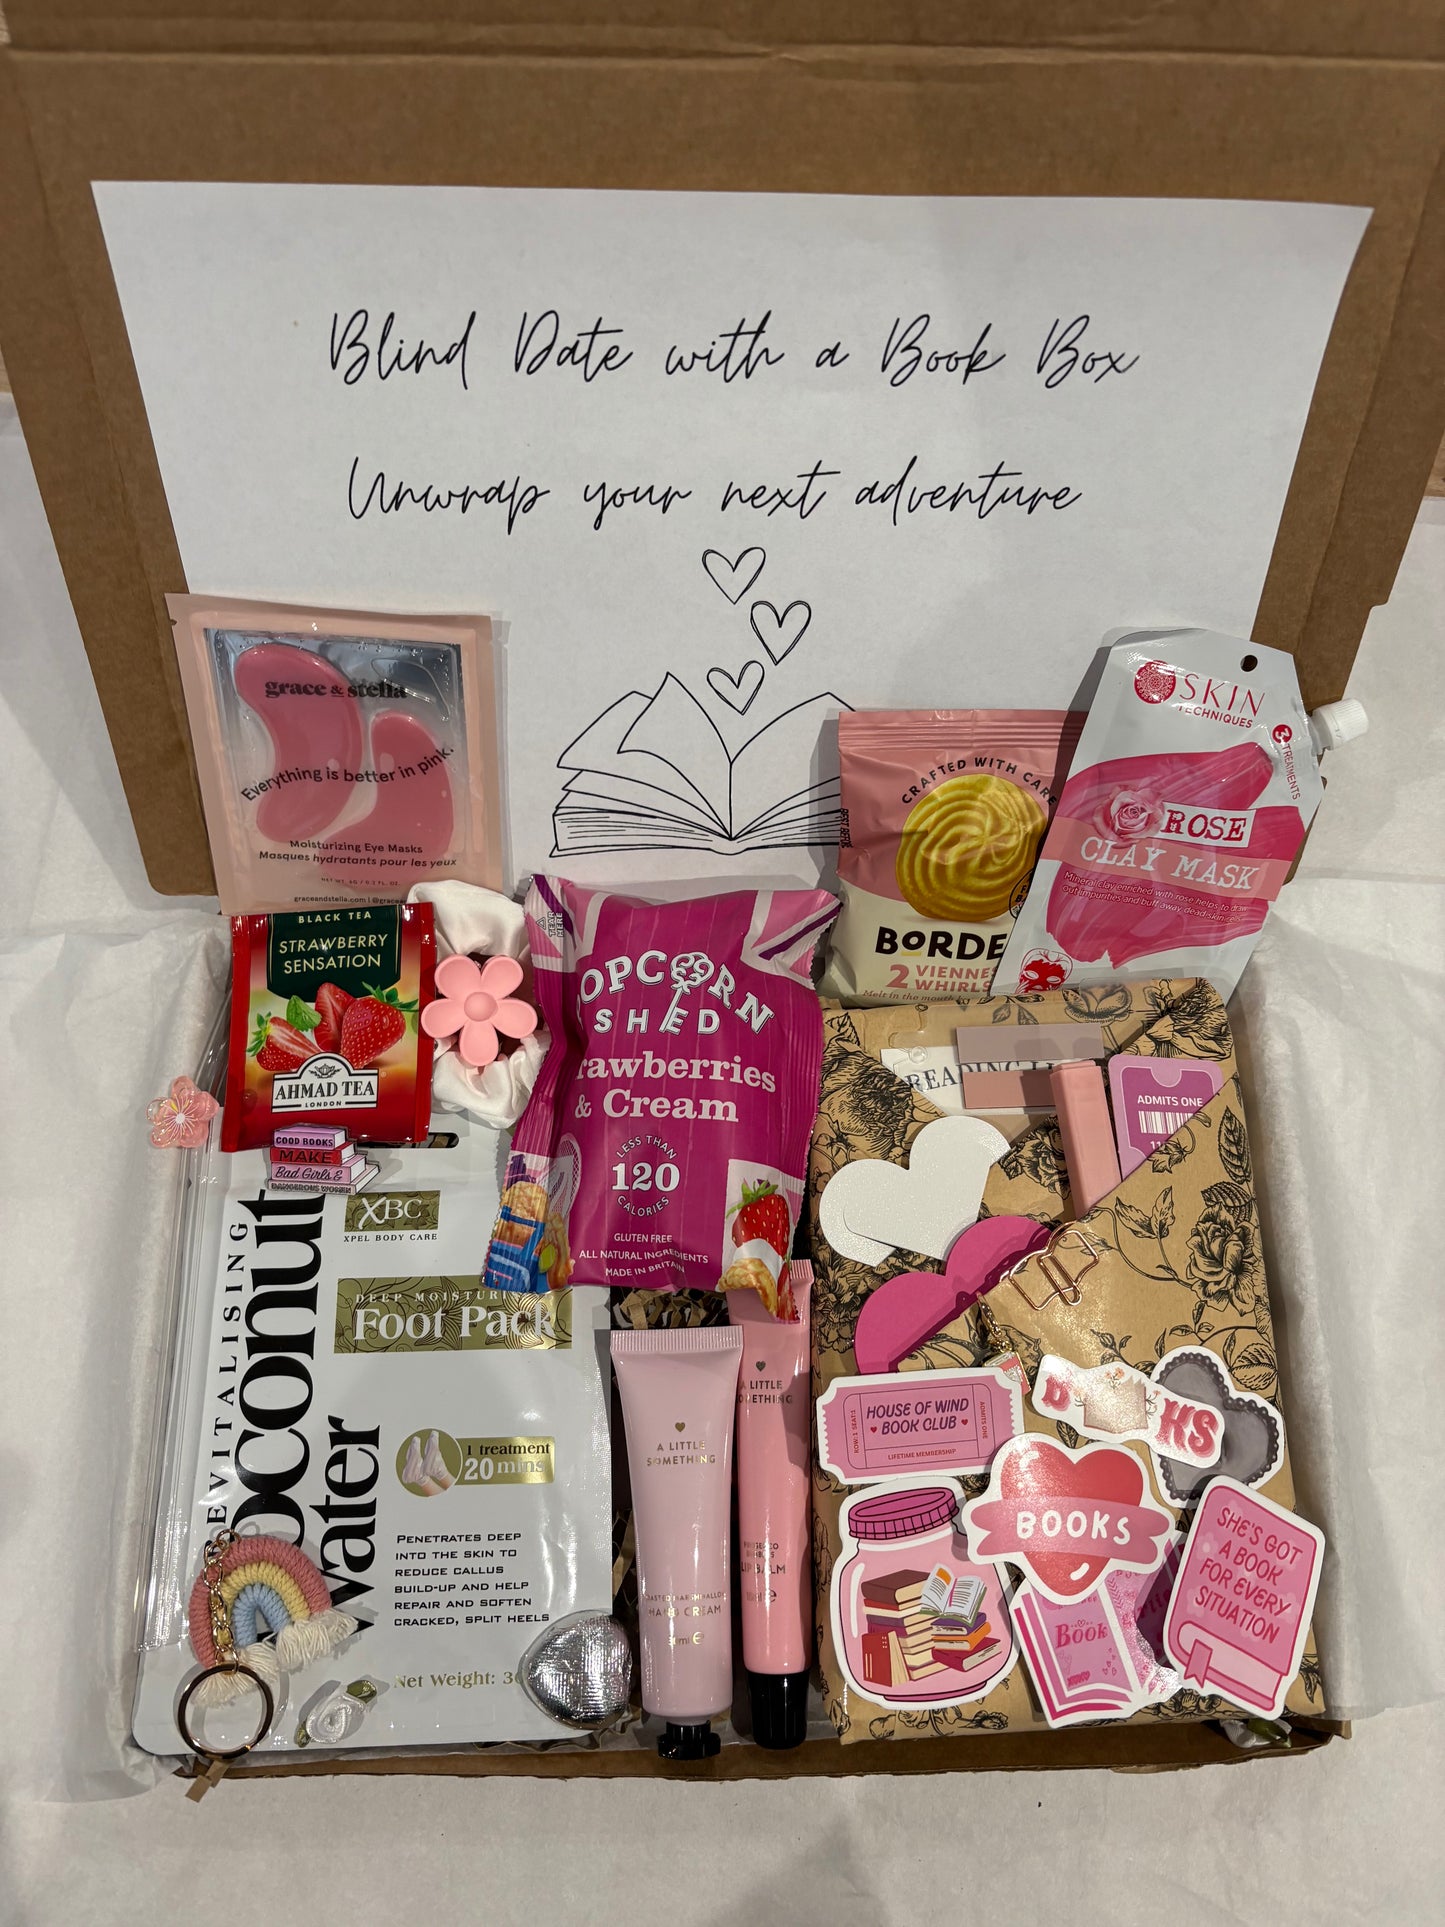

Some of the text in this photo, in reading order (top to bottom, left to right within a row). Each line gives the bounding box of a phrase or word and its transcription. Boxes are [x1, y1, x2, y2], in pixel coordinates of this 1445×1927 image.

[330, 309, 1140, 389] Blind Date with a Book Box
[348, 456, 1083, 534] Unwrap your next adventure
[265, 679, 408, 699] grace & stella
[1179, 674, 1265, 717] SKIN
[240, 746, 455, 801] Everything is better in pink.
[902, 757, 1057, 806] CRAFTED WITH CARE
[1281, 743, 1301, 800] TREATMENTS
[1160, 809, 1249, 842] ROSE
[290, 840, 423, 854] Moisturizing Eye Masks
[259, 851, 457, 868] Masques hydratants pour les yeux
[1080, 837, 1259, 890] CLAY MASK
[294, 895, 368, 904] graceandstella.com
[1064, 871, 1098, 887] Mineral
[1098, 880, 1116, 891] clay
[1116, 883, 1153, 896] enriched
[1155, 889, 1175, 899] with
[1175, 894, 1194, 903] rose
[1196, 897, 1218, 909] helps
[1220, 904, 1230, 912] to
[1062, 885, 1225, 922] out impurities and buff away dead skin
[298, 911, 372, 924] BLACK TEA
[547, 911, 557, 937] TEAR
[556, 912, 564, 937] HERE
[279, 934, 388, 954] STRAWBERRY
[875, 926, 1007, 961] BORDE
[284, 954, 381, 974] SENSATION
[886, 964, 997, 989] 2 VIENNES
[915, 979, 990, 993] WHIRLS
[577, 949, 775, 1034] OPCORN
[862, 990, 886, 999] Melt
[889, 992, 899, 1000] in
[903, 992, 919, 1001] the
[594, 1005, 721, 1036] SHED
[576, 1050, 776, 1093] rawberries
[275, 1080, 375, 1101] AHMAD TEA
[575, 1089, 739, 1123] & Cream
[1137, 1095, 1203, 1107] ADMITS ONE
[303, 1138, 333, 1147] BOOKS
[616, 1134, 678, 1159] LESS THAN
[280, 1150, 333, 1164] MAKE
[275, 1166, 343, 1181] Bad Girls &
[611, 1162, 681, 1193] 120
[271, 1183, 320, 1192] DANGEROUS
[358, 1196, 422, 1230] XBC
[616, 1194, 670, 1217] CALORIES
[344, 1233, 437, 1242] XPEL BODY CARE
[614, 1233, 672, 1243] GLUTEN FREE
[579, 1248, 709, 1264] ALL NATURAL INGREDIENTS
[605, 1260, 685, 1277] MADE IN BRITAIN
[355, 1293, 402, 1303] DEEP
[353, 1302, 555, 1341] Foot Pack
[231, 1189, 326, 1549] oconut
[750, 1380, 783, 1390] LITTLE
[866, 1398, 969, 1419] HOUSE OF WIND
[882, 1416, 957, 1435] BOOK CLUB
[479, 1442, 550, 1455] treatment
[656, 1440, 705, 1451] A LITTLE
[916, 1448, 957, 1458] MEMBERSHIP
[464, 1457, 545, 1481] 20 mins
[647, 1454, 716, 1467] SOMETHING
[1016, 1510, 1131, 1545] BOOKS
[1217, 1507, 1303, 1565] SHE'S GOT
[396, 1532, 522, 1544] PENETRATES DEEP
[395, 1549, 517, 1560] INTO THE SKIN TO
[1219, 1540, 1283, 1586] A BOOK
[395, 1566, 504, 1577] REDUCE CALLUS
[741, 1561, 752, 1572] LIP
[394, 1581, 529, 1593] BUILD-UP AND HELP
[1200, 1558, 1292, 1616] FOR EVERY
[394, 1598, 532, 1610] REPAIR AND SOFTEN
[684, 1605, 722, 1616] CREAM
[394, 1613, 550, 1627] CRACKED, SPLIT HEELS
[1195, 1585, 1280, 1644] SITUATION
[1055, 1623, 1108, 1649] Book
[393, 1675, 423, 1688] Net
[430, 1672, 495, 1690] Weight:
